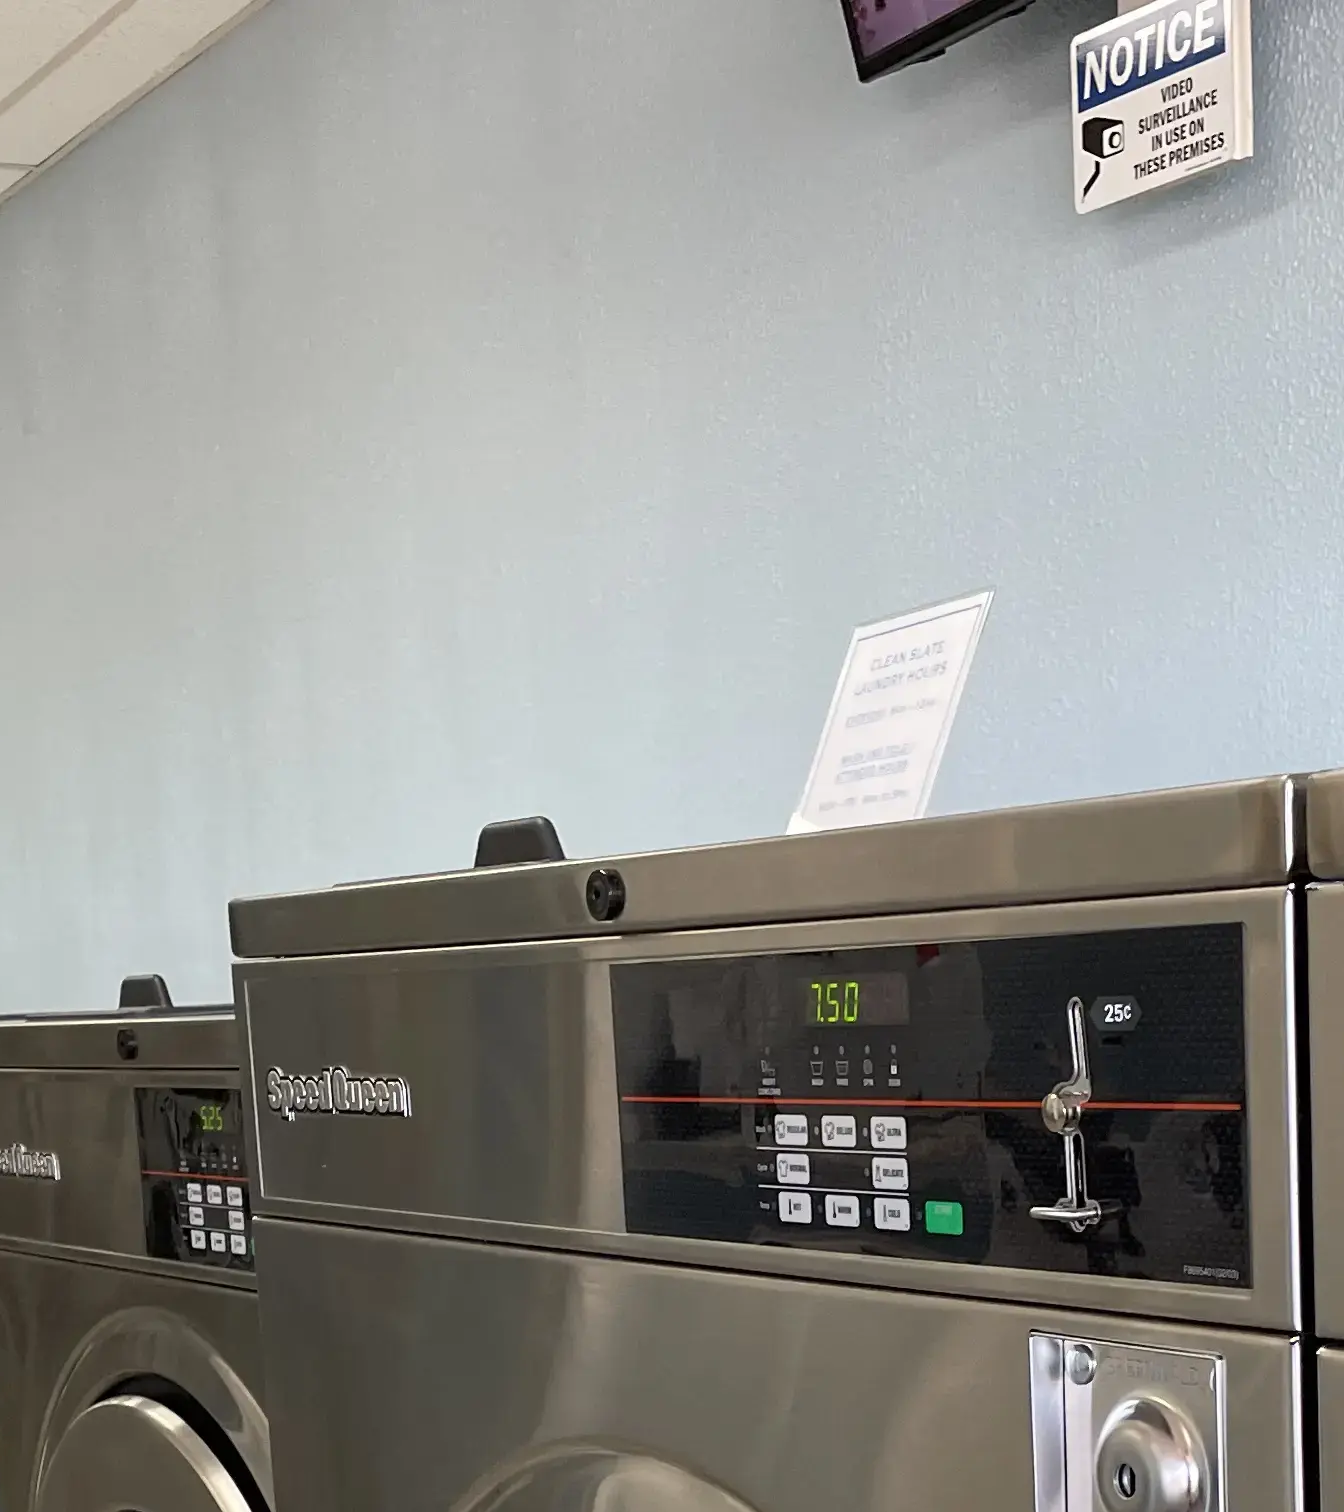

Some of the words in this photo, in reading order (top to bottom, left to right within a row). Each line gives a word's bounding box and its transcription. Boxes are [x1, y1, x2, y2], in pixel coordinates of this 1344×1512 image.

[1083, 0, 1219, 100] NOTICE
[1161, 77, 1193, 104] VIDEO
[1138, 89, 1218, 135] SURVEILLANCE
[1151, 135, 1163, 152] IN
[1165, 127, 1188, 148] USE
[1188, 117, 1205, 138] ON
[1133, 151, 1166, 181] THESE
[1169, 132, 1225, 168] PREMISES
[870, 652, 907, 672] CLEAN
[909, 640, 946, 662] SLATE
[810, 981, 860, 1023] 7.50
